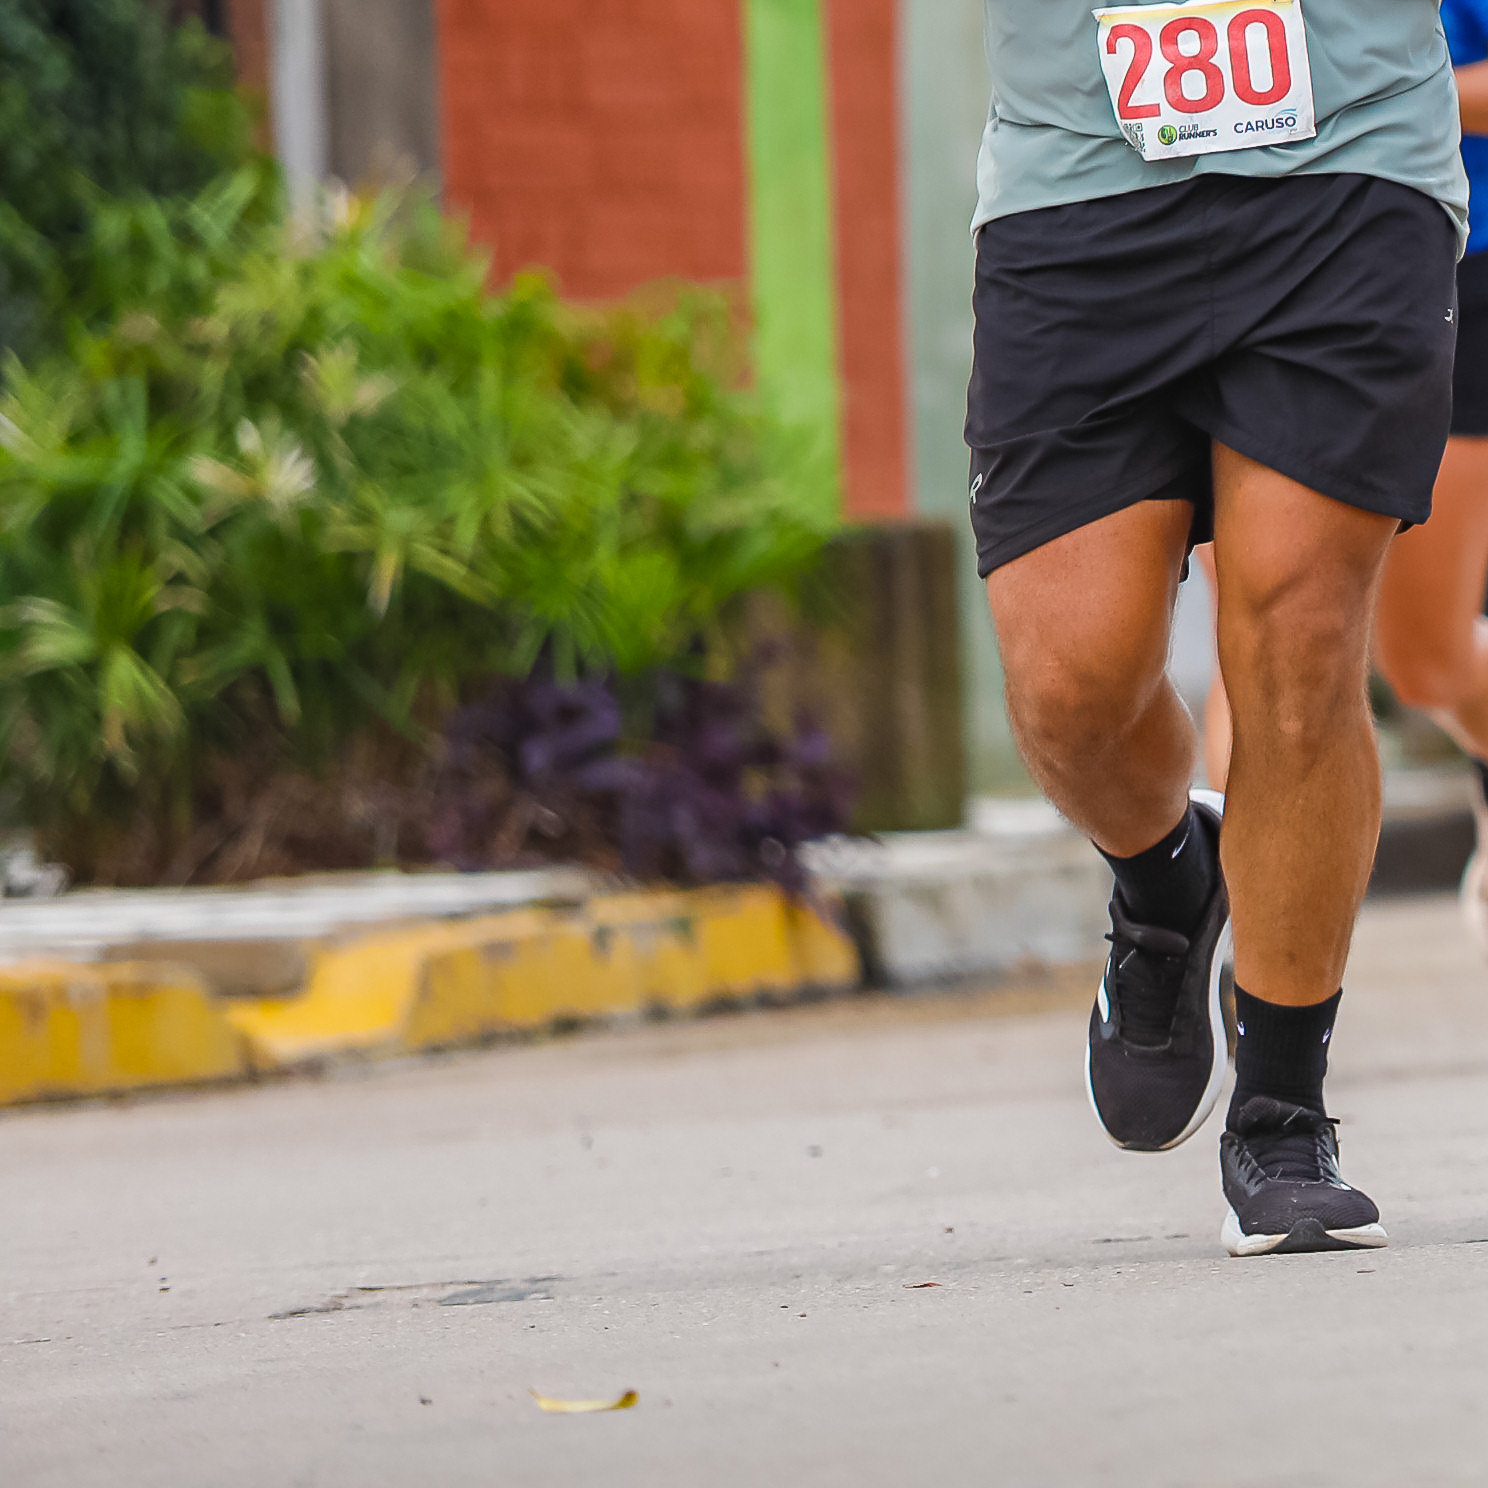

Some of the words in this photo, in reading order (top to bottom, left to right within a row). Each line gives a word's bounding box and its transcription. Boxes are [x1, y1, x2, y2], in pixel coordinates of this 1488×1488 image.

[1106, 8, 1292, 120] 280
[1178, 123, 1199, 133] CLUB
[1233, 116, 1297, 134] CARUSO
[1178, 129, 1218, 141] RUNNER'S
